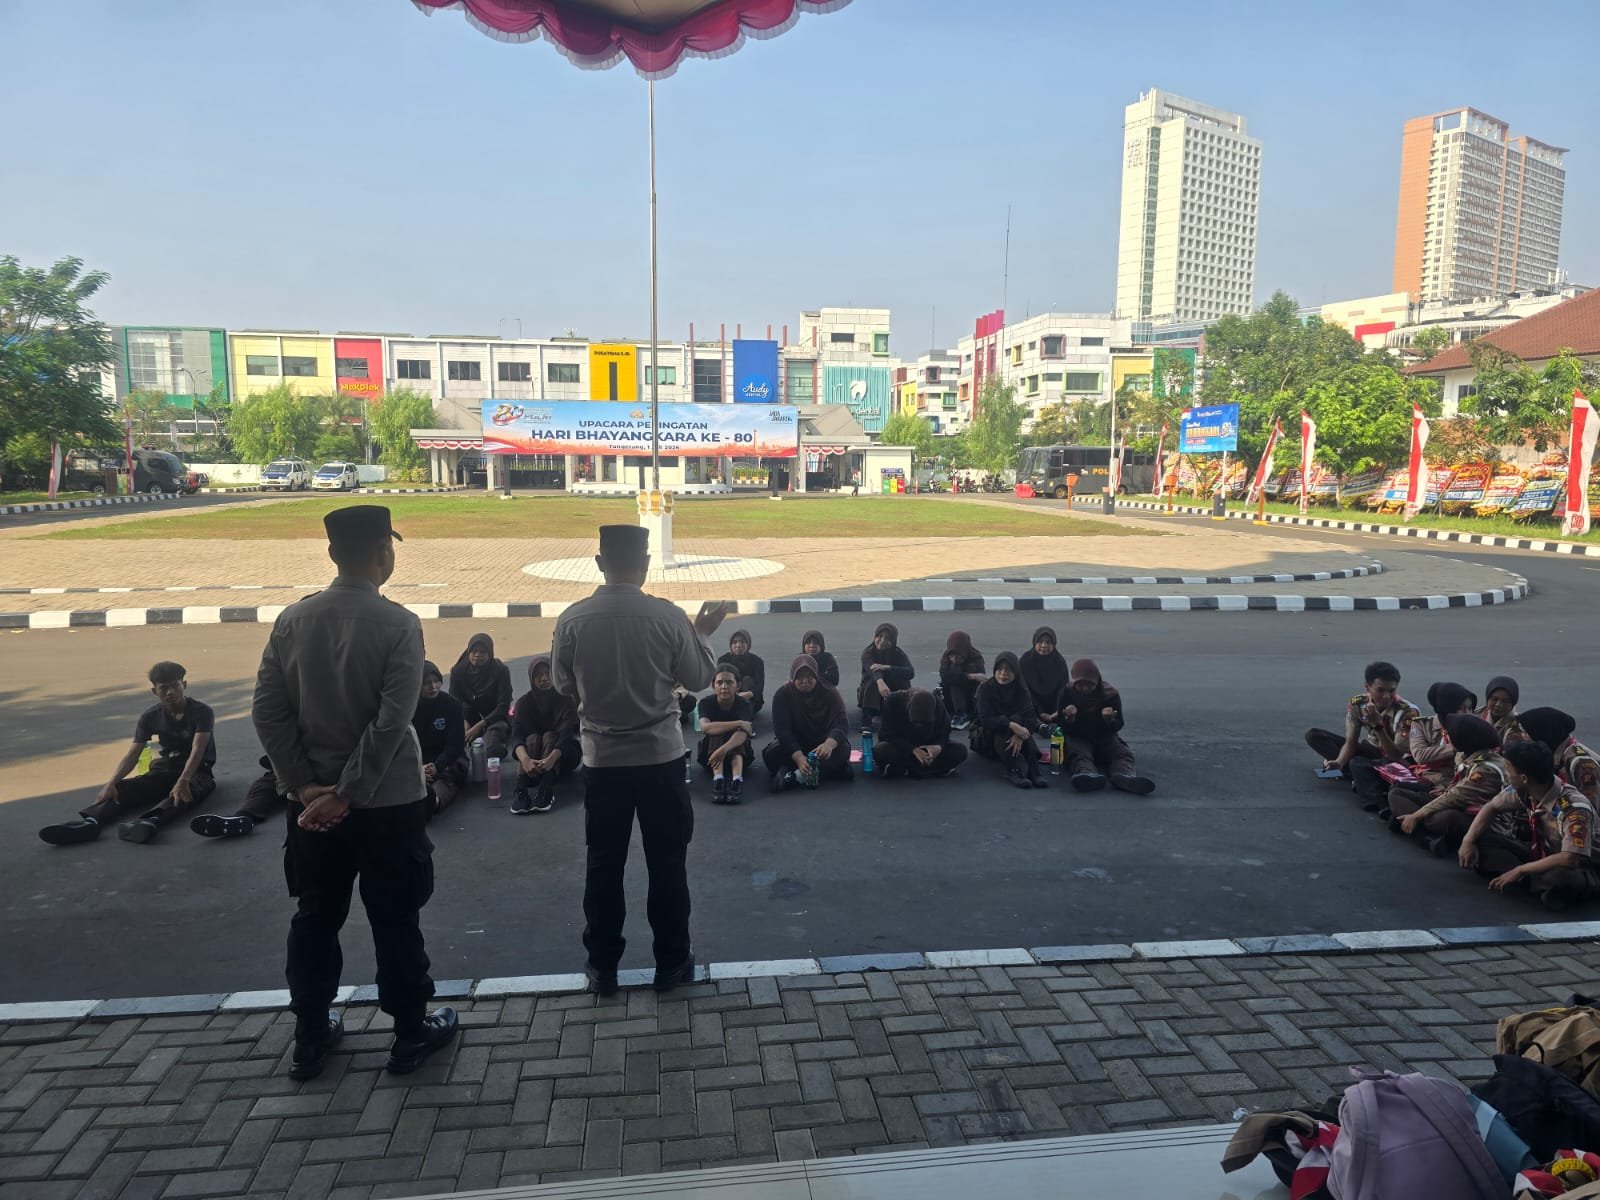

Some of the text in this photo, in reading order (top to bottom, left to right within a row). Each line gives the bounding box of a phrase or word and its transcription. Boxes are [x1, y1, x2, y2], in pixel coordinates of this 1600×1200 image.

[742, 382, 770, 398] Audy
[637, 421, 708, 430] PEINGATAN
[532, 430, 570, 440] HARI
[576, 430, 696, 442] BHAYANGKARA
[701, 433, 720, 442] KE
[734, 433, 752, 442] 80
